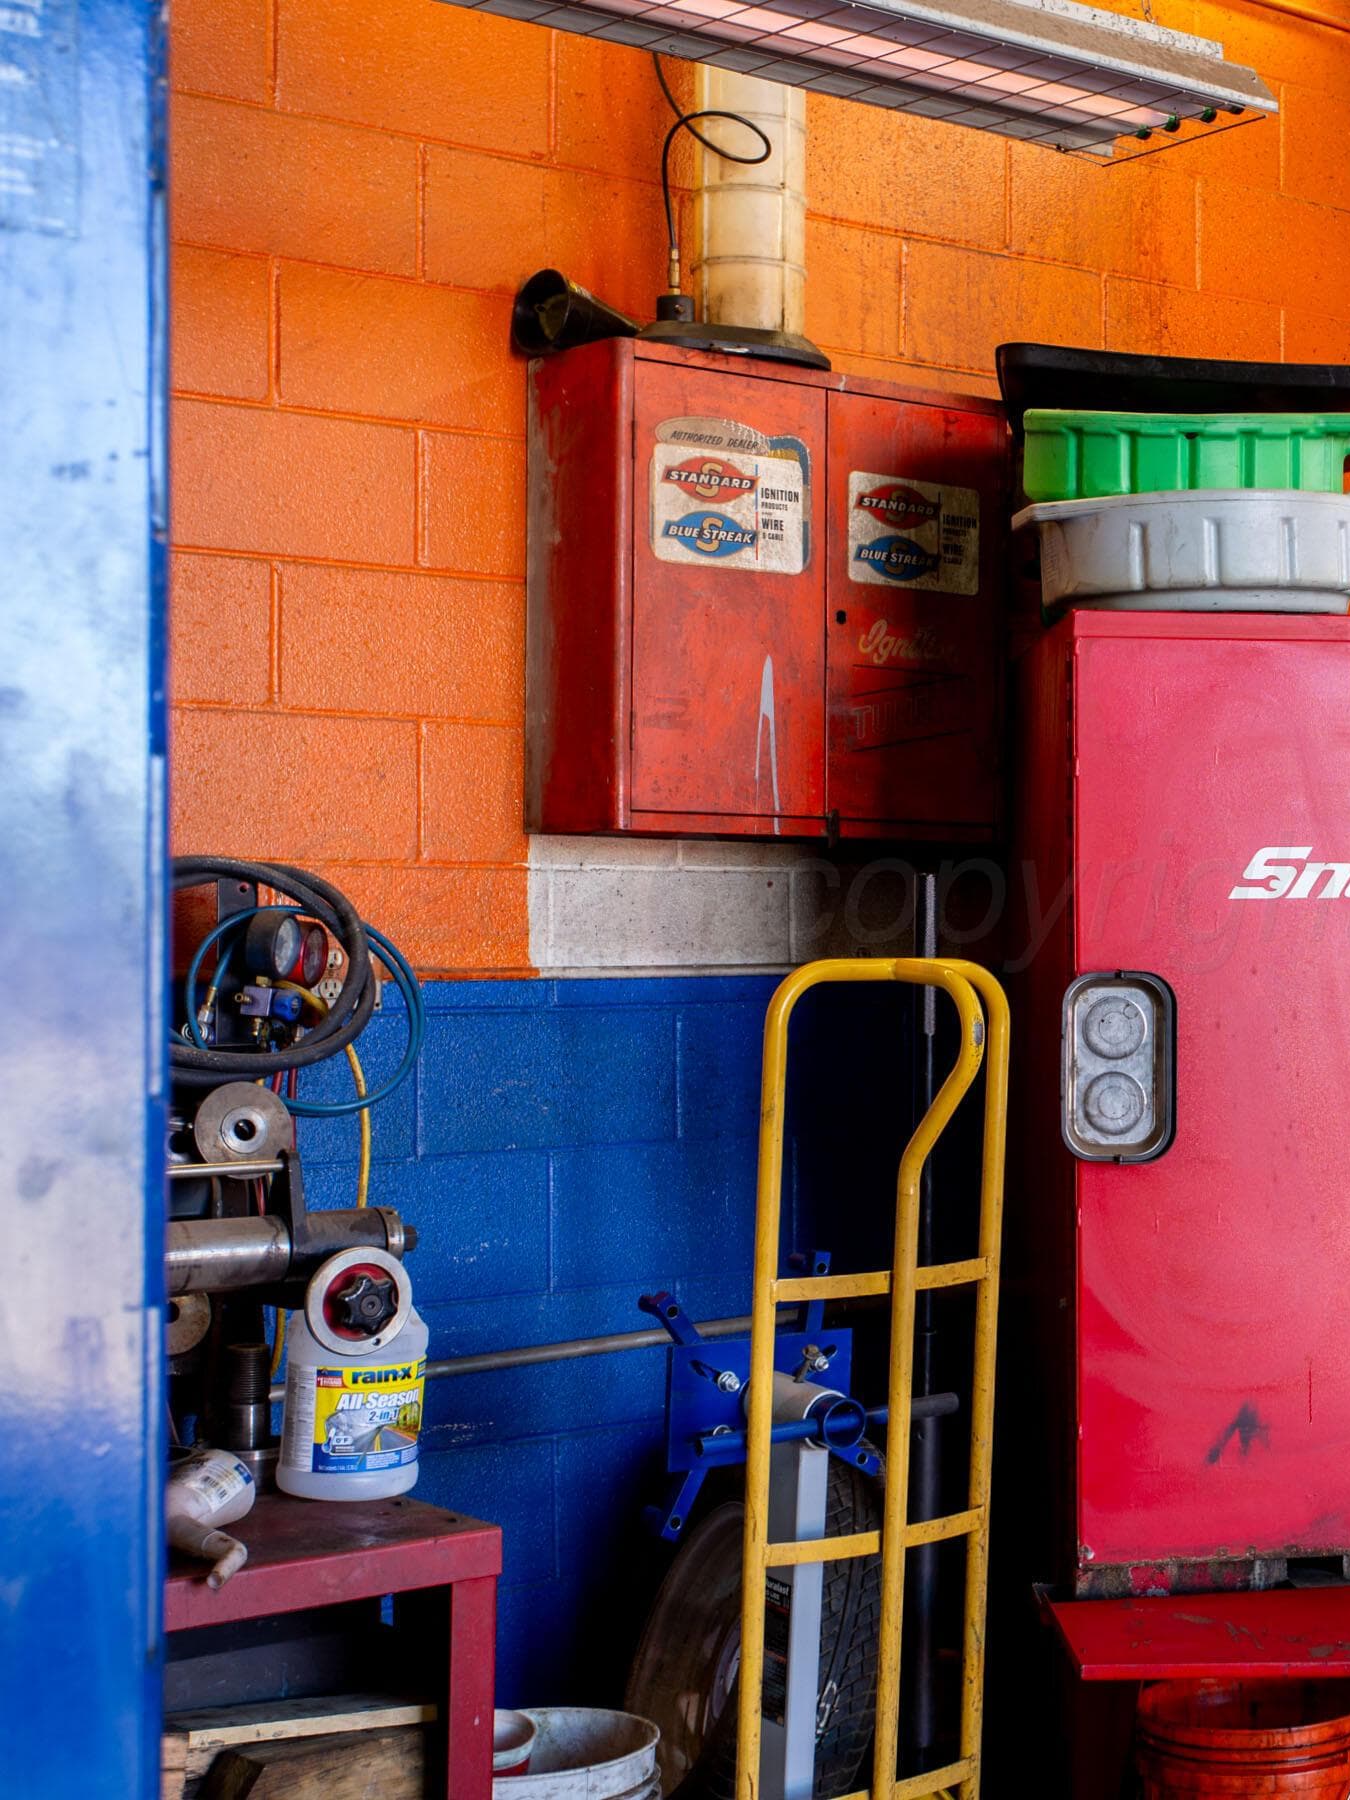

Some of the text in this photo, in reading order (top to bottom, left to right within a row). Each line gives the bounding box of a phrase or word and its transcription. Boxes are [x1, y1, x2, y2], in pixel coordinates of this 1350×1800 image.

[670, 430, 759, 450] AUTHORIZED DEALER
[669, 470, 752, 490] STANDARD
[760, 487, 800, 503] IGNITION
[760, 502, 788, 511] PRODUCTS
[861, 496, 934, 516] STANDARD
[761, 518, 784, 532] WIRE
[942, 513, 977, 529] IGNITION
[668, 525, 754, 544] BLUE STREAK
[768, 533, 784, 541] CABLE
[860, 548, 887, 561] BLUE
[335, 1386, 420, 1410] All Season
